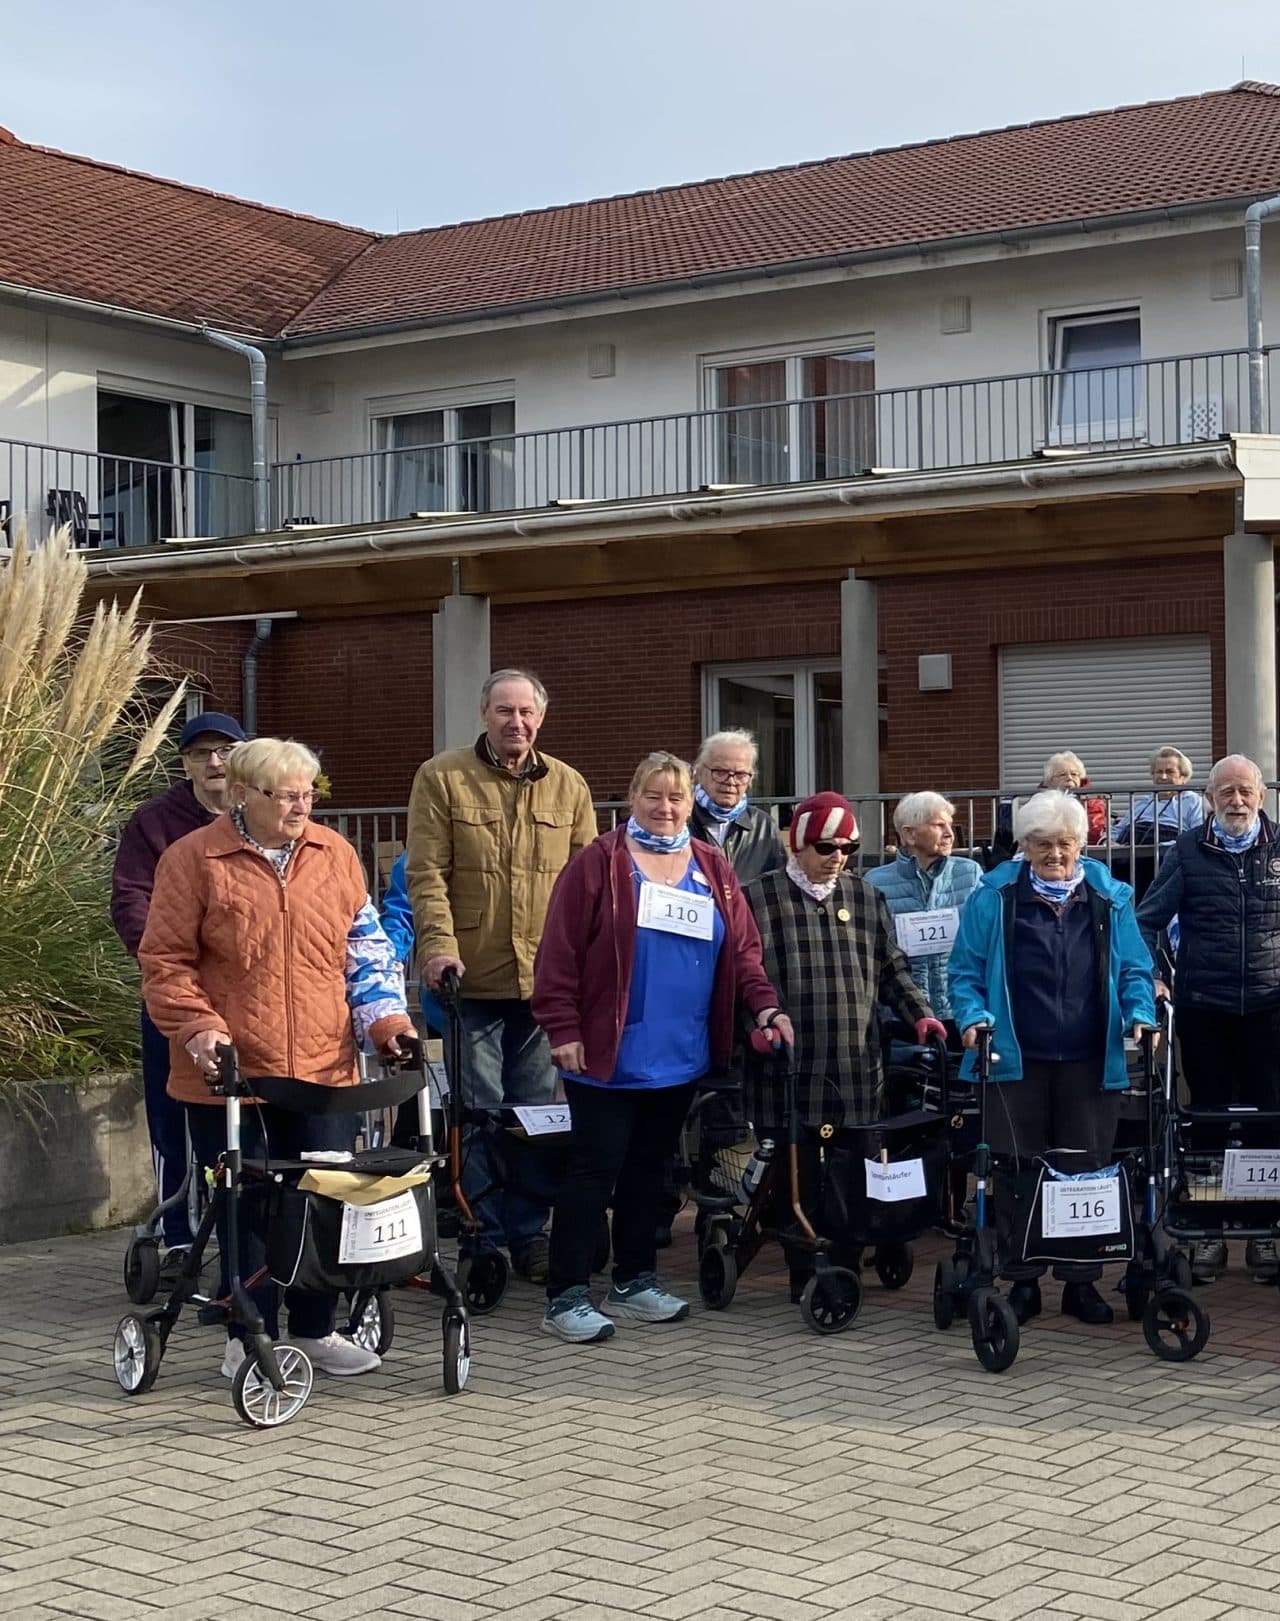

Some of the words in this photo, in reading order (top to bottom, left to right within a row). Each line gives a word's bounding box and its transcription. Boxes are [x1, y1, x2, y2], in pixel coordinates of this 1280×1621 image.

[664, 903, 698, 923] 110
[918, 925, 948, 942] 121
[544, 1114, 569, 1124] 12
[1246, 1167, 1279, 1182] 114
[1068, 1199, 1105, 1219] 116
[373, 1218, 408, 1244] 111
